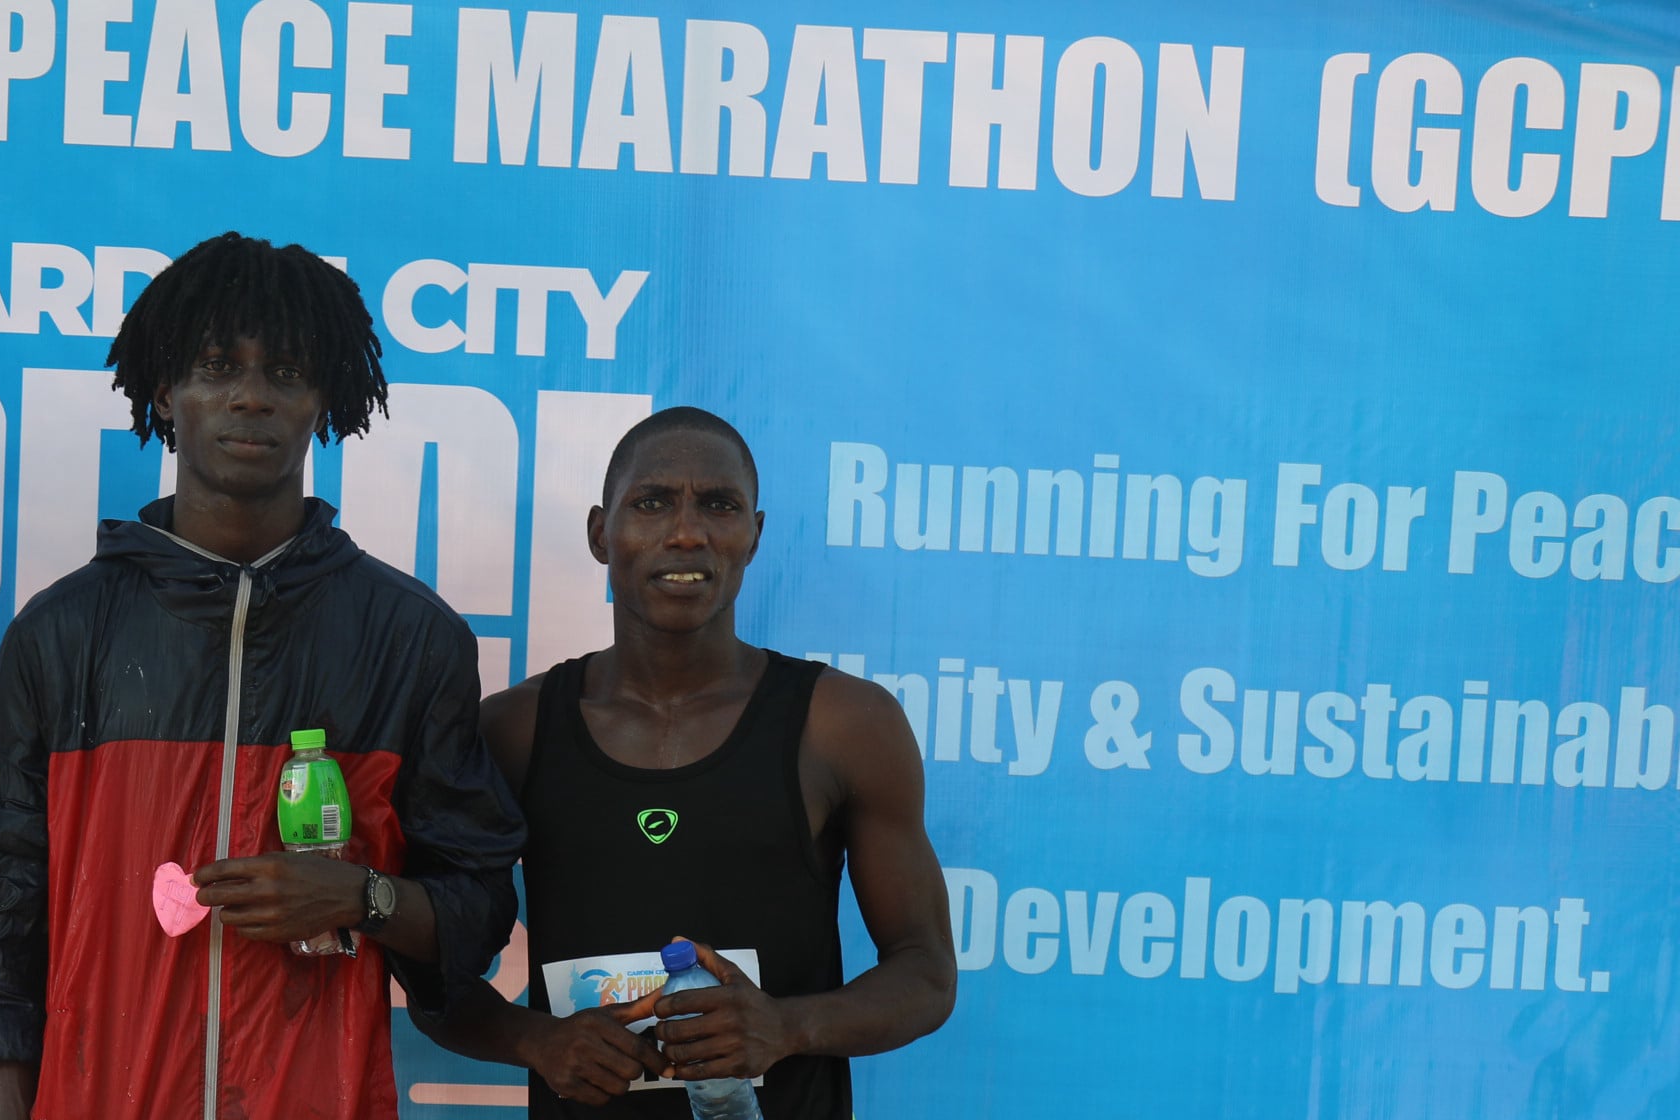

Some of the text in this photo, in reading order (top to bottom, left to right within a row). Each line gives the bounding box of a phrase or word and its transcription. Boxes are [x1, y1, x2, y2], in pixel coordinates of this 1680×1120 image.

[453, 8, 1245, 201] MARATHON
[382, 258, 650, 360] CITY
[826, 441, 1248, 578] Running
[1272, 462, 1427, 572] For
[806, 652, 1680, 792] nity & Sustainab
[938, 866, 1611, 994] Development.
